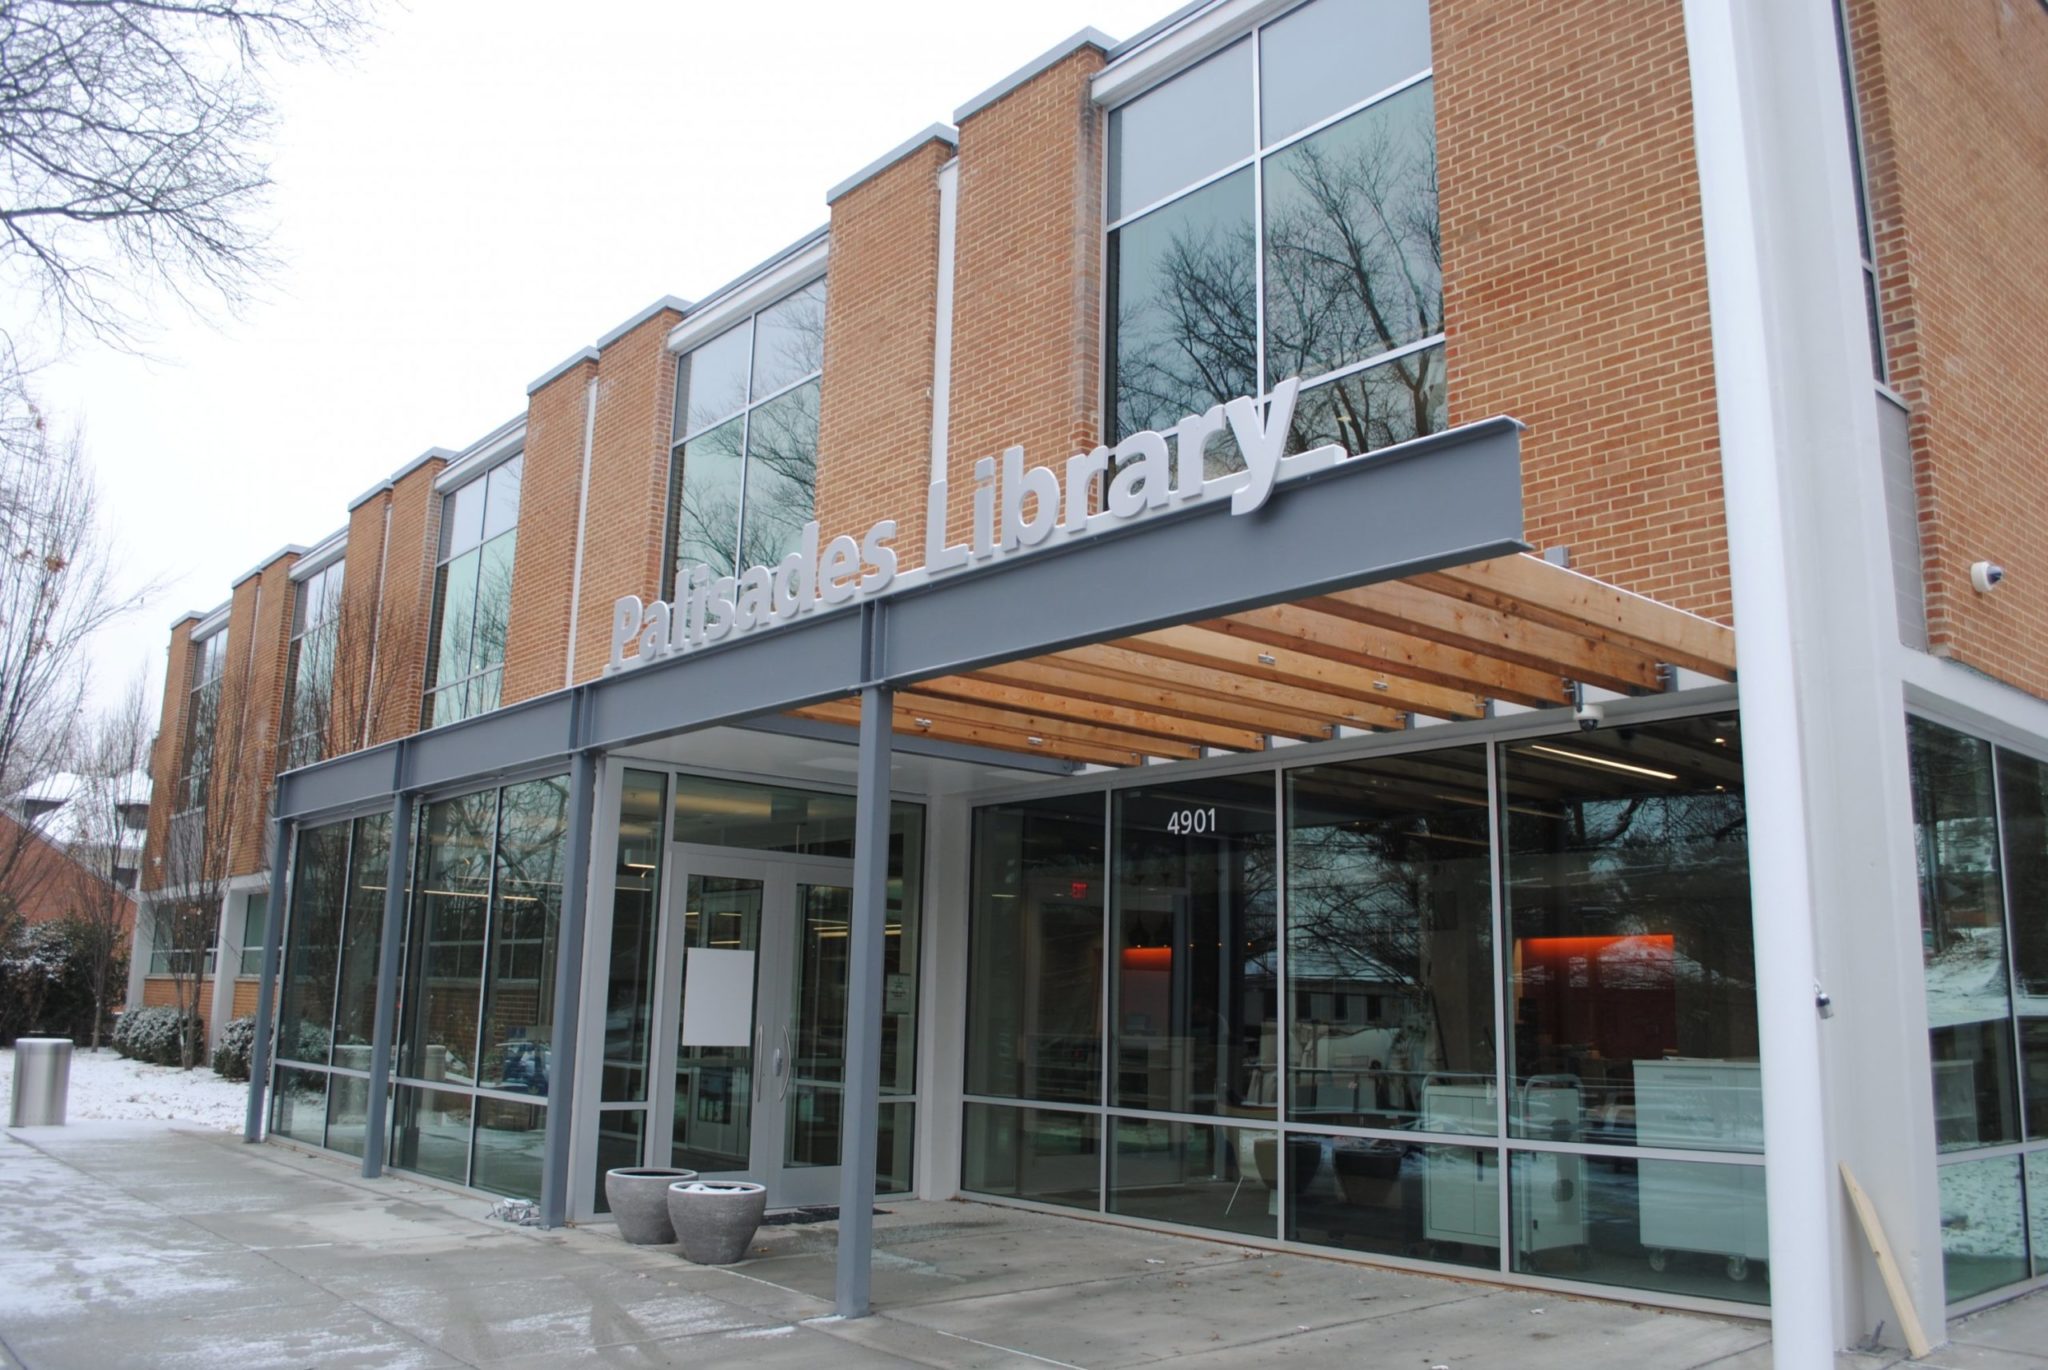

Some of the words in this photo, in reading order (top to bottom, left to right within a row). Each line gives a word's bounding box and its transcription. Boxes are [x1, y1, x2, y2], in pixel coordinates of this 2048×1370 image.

[610, 519, 898, 670] Palisades
[925, 376, 1299, 574] Library
[1167, 807, 1216, 835] 4901
